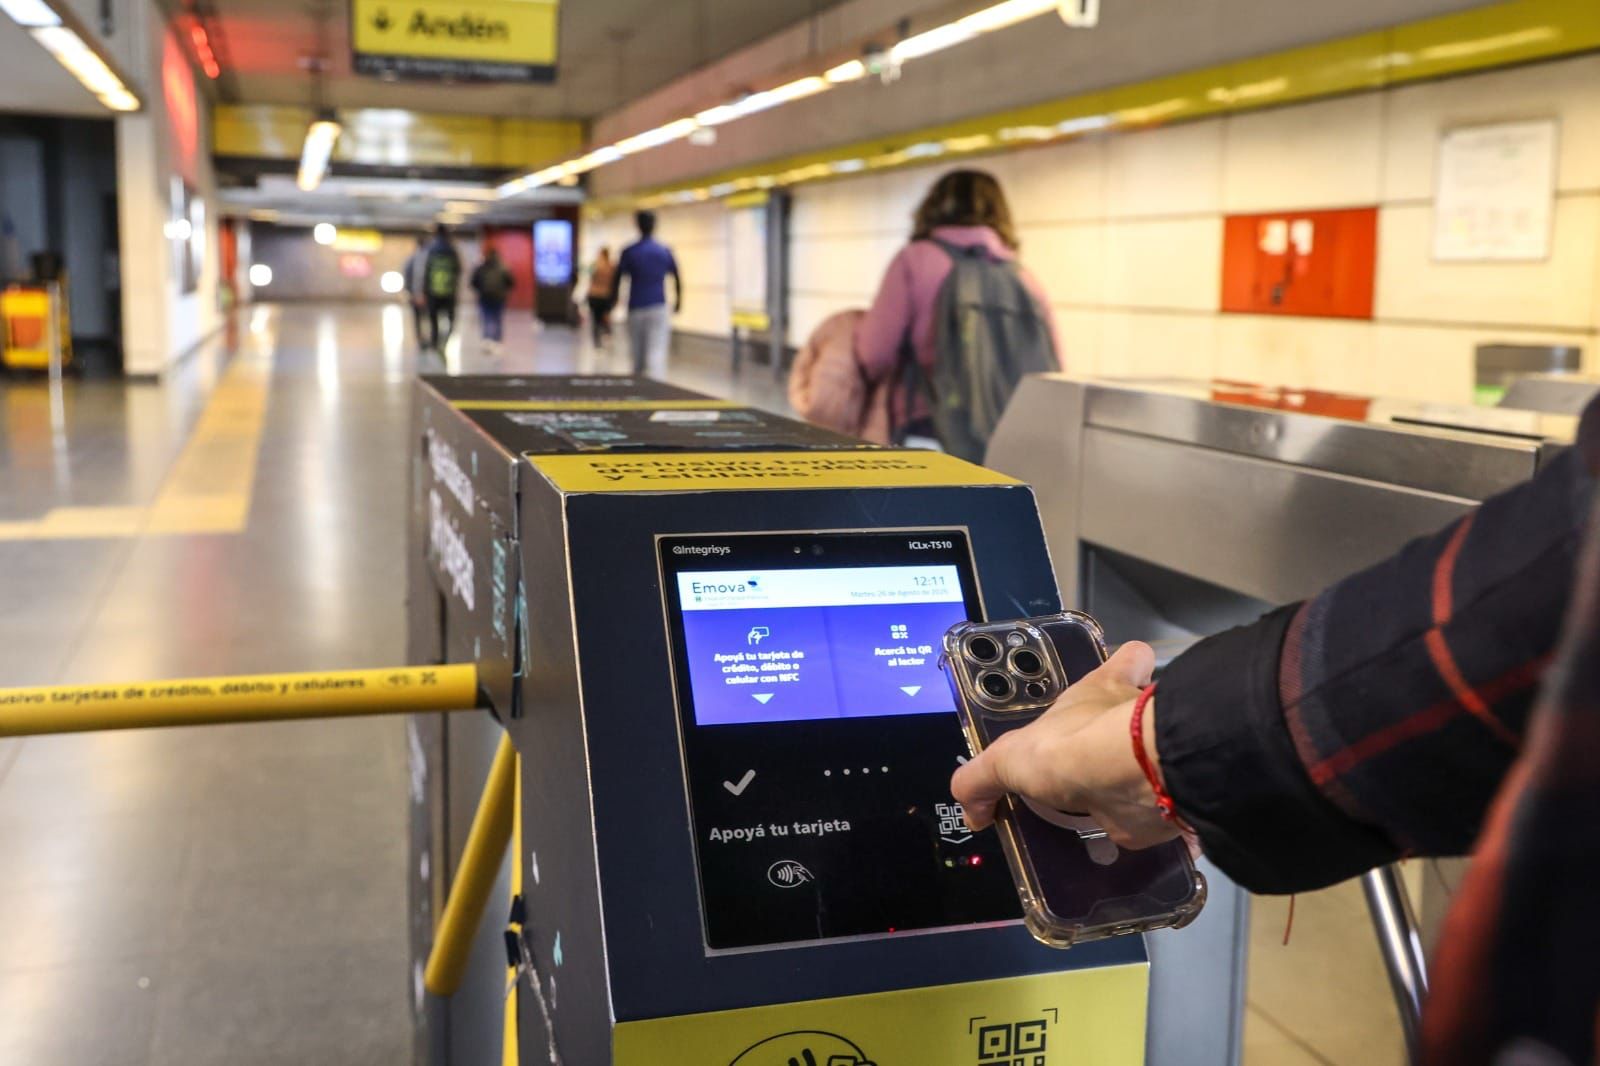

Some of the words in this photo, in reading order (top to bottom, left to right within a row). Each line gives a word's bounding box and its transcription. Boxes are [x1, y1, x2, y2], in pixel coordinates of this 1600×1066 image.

[913, 576, 945, 586] 12:11
[692, 581, 746, 594] Emova
[918, 646, 931, 654] QR
[714, 653, 744, 662] Apoyá
[759, 652, 790, 661] tarjeta
[792, 651, 804, 659] de
[888, 658, 897, 666] al
[899, 657, 924, 665] lector
[722, 663, 759, 673] crédito,
[761, 662, 791, 671] débito
[726, 675, 758, 684] celular
[780, 673, 799, 682] NFC
[51, 690, 118, 704] tarjetas
[124, 688, 145, 699] de
[221, 680, 275, 694] débito
[280, 684, 290, 694] y
[294, 677, 365, 691] celulares
[709, 824, 765, 843] Apoyá
[770, 824, 788, 836] tu
[793, 819, 850, 836] tarjeta
